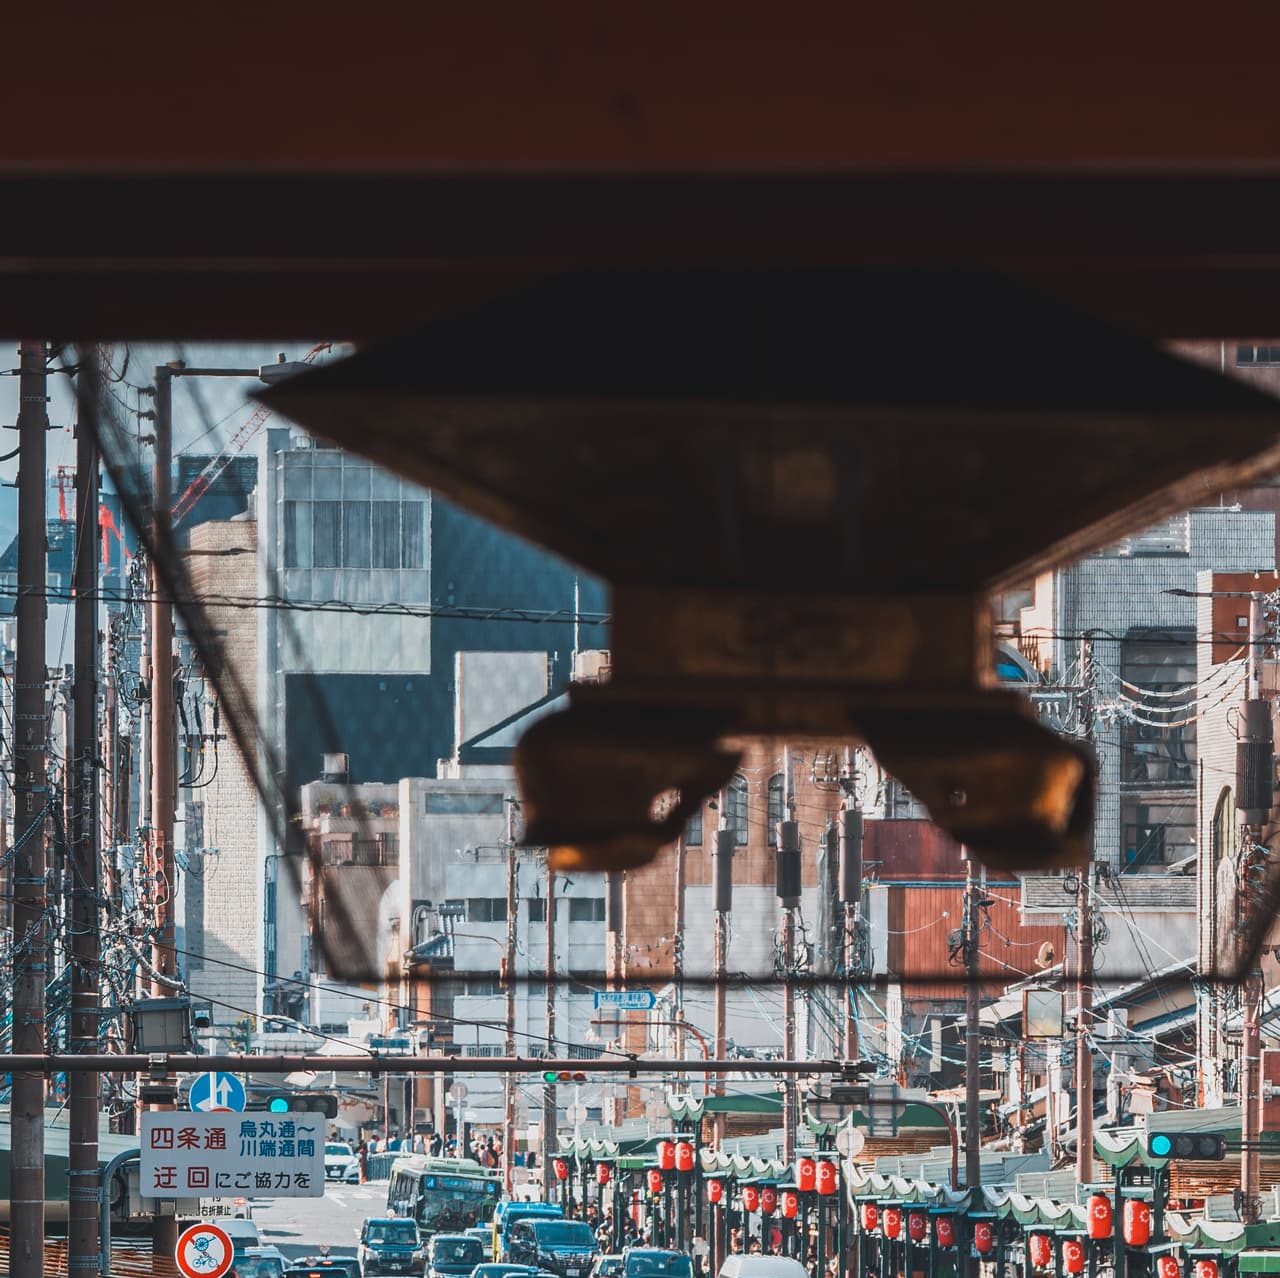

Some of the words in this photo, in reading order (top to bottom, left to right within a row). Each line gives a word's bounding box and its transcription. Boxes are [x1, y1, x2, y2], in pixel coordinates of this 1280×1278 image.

[151, 1127, 226, 1149] 四条通
[239, 1140, 314, 1157] 川端通間
